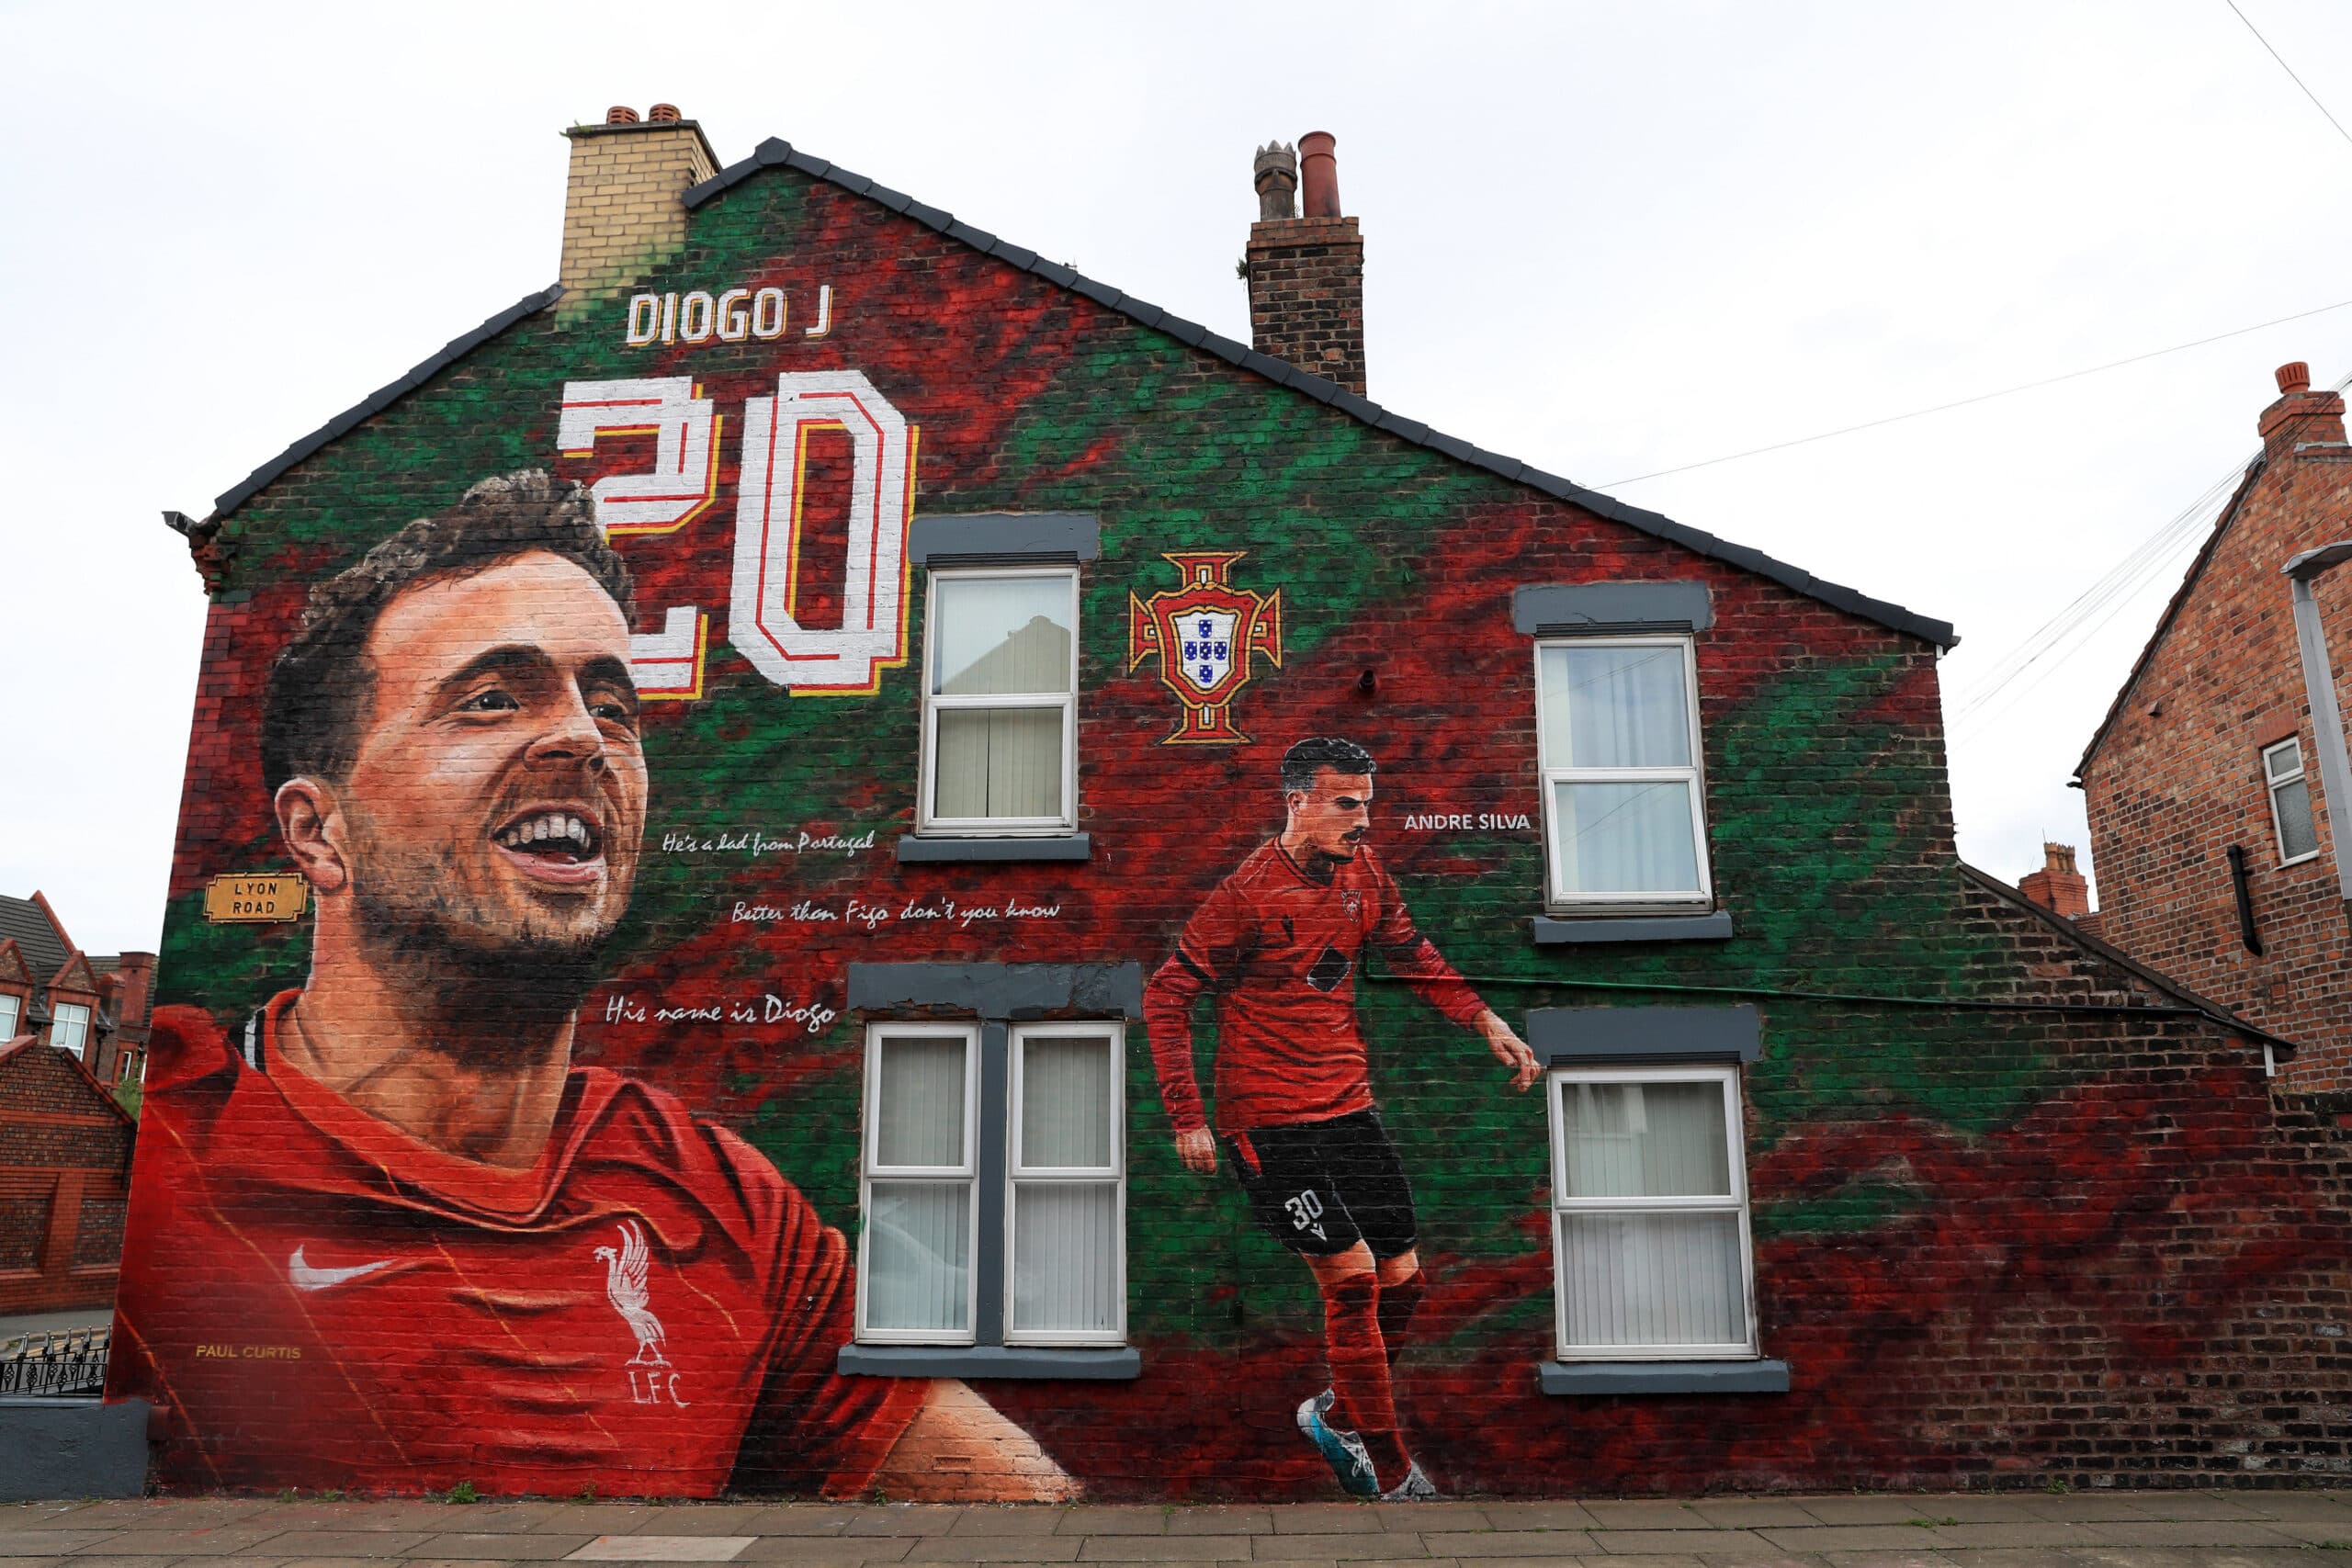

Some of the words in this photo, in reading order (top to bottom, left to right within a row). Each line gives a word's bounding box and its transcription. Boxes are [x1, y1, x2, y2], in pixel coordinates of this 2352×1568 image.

[627, 287, 787, 346] DIOGO
[806, 285, 832, 338] J
[556, 369, 920, 700] 20
[1404, 814, 1473, 830] ANDRE
[1478, 813, 1532, 830] SILVA
[662, 833, 698, 854] He's
[701, 840, 713, 851] a
[717, 833, 749, 851] lad
[752, 831, 794, 856] from
[797, 830, 876, 857] Portugal
[234, 883, 277, 896] LYON
[232, 901, 276, 915] ROAD
[732, 900, 784, 923] Better
[790, 902, 838, 920] than
[845, 900, 889, 930] Figo
[900, 897, 956, 919] don't
[960, 907, 999, 928] you
[1006, 898, 1060, 919] know
[605, 995, 647, 1024] His
[654, 1005, 723, 1023] name
[730, 1001, 757, 1022] is
[763, 993, 836, 1032] Diogo
[1284, 1189, 1324, 1231] 30
[196, 1345, 238, 1358] PAUL
[243, 1346, 301, 1359] CURTIS
[628, 1371, 691, 1408] LFC
